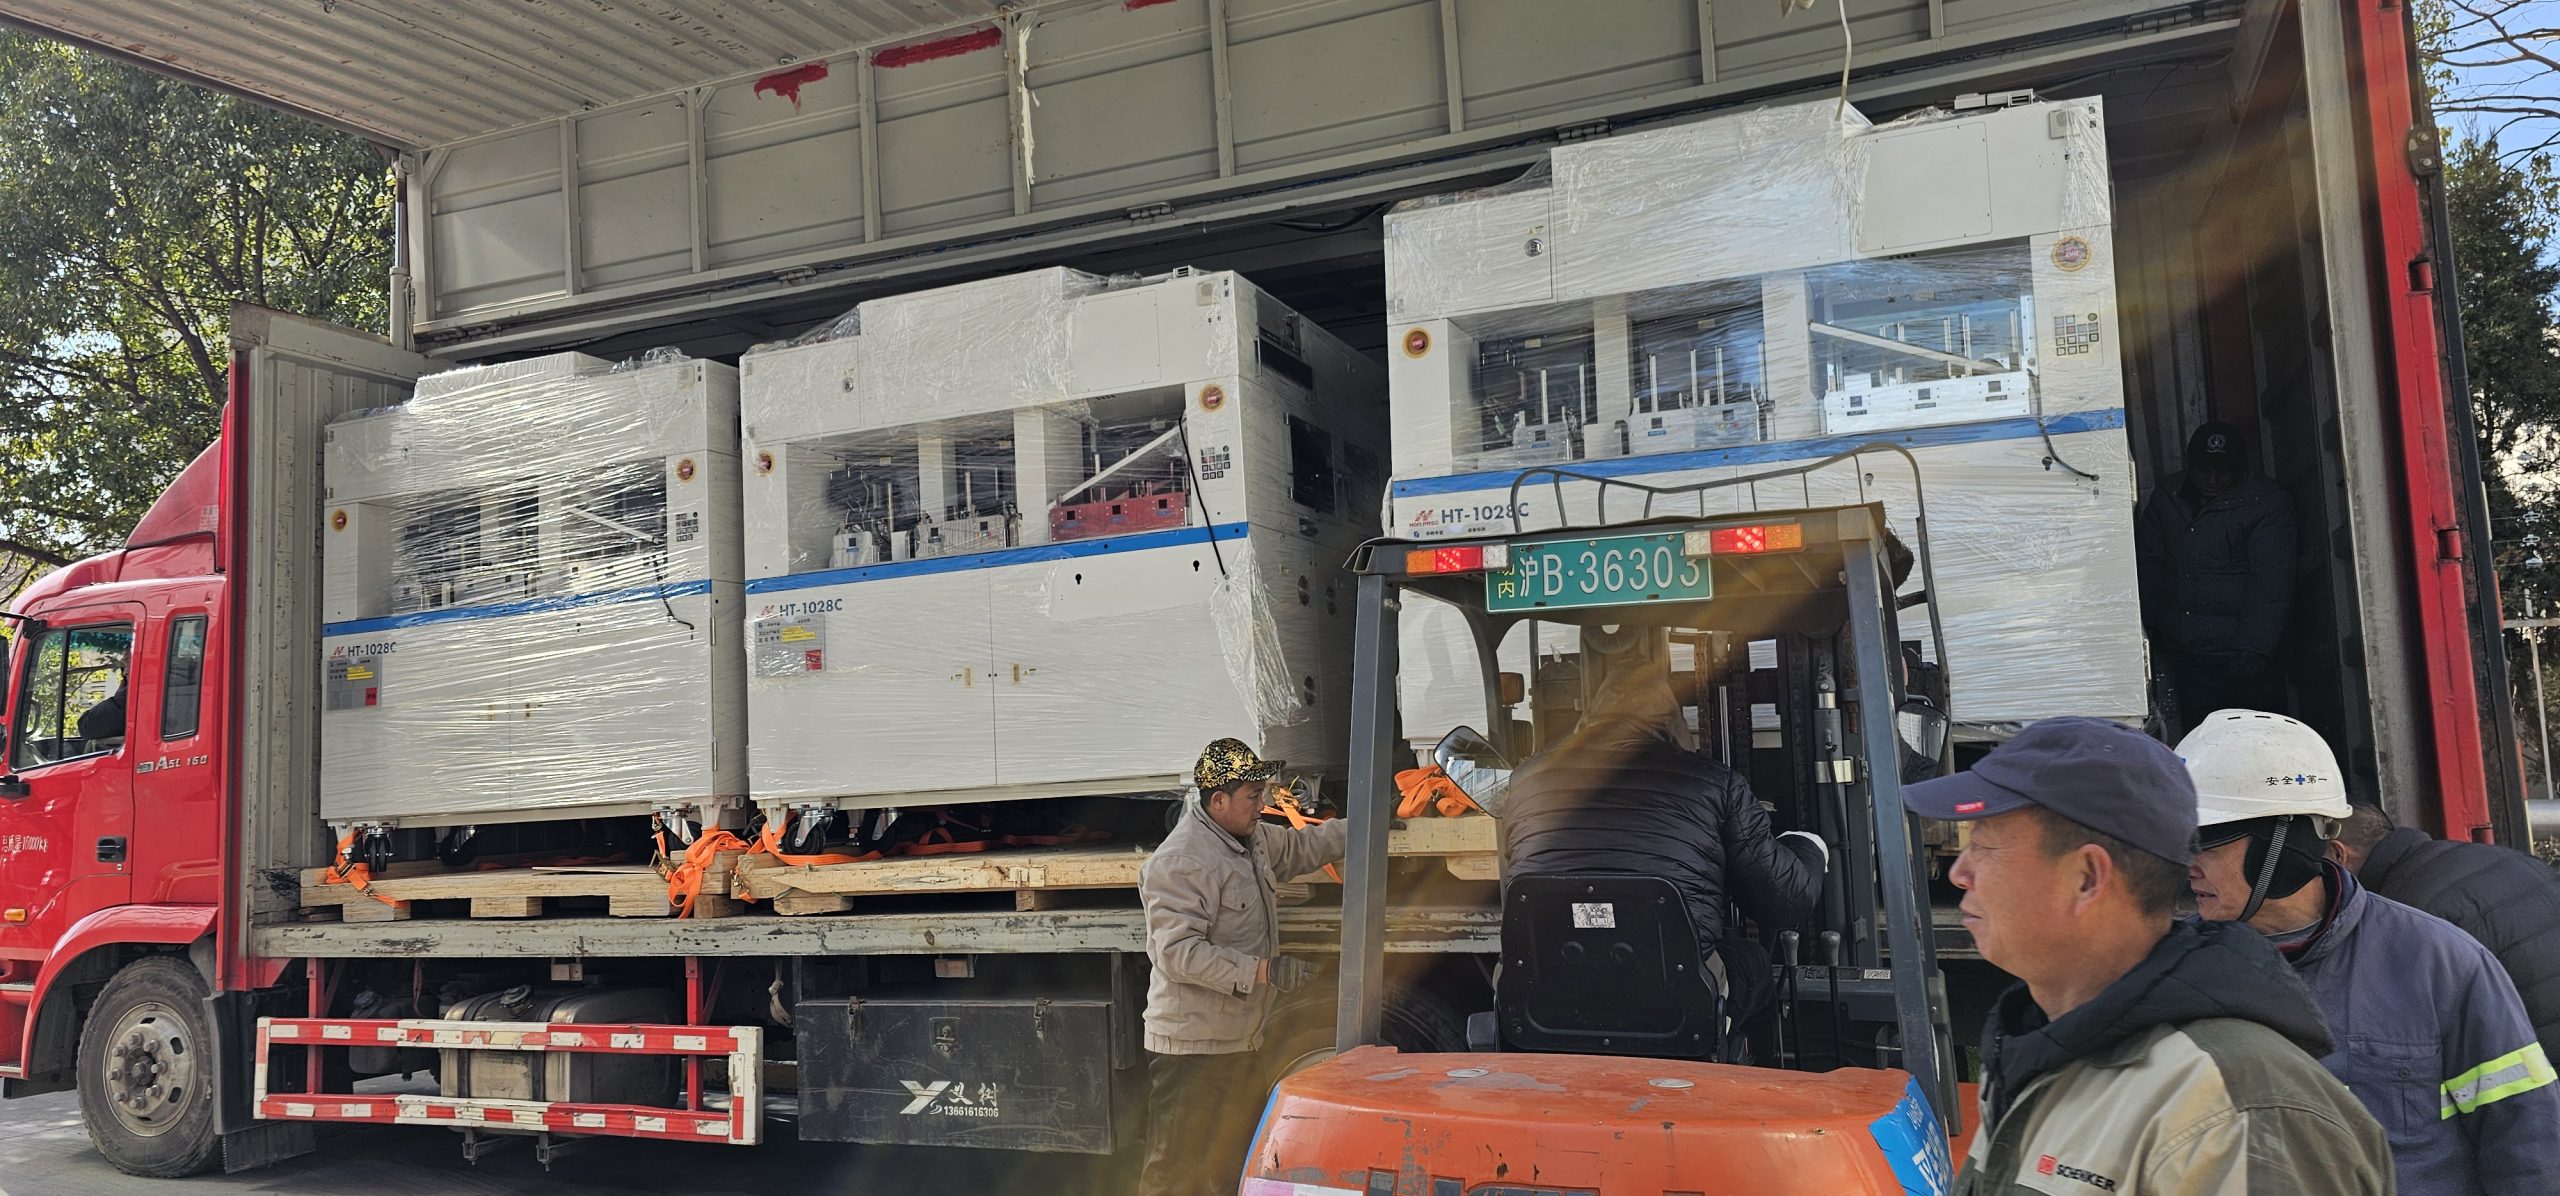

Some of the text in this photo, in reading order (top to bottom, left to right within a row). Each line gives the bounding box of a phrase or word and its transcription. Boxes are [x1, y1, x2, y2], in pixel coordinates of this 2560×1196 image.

[779, 598, 843, 617] HT-1028C
[347, 641, 397, 657] HT-1028C
[187, 755, 208, 766] 160
[2265, 774, 2328, 787] 安全 第一
[943, 1105, 999, 1118] 13661616306
